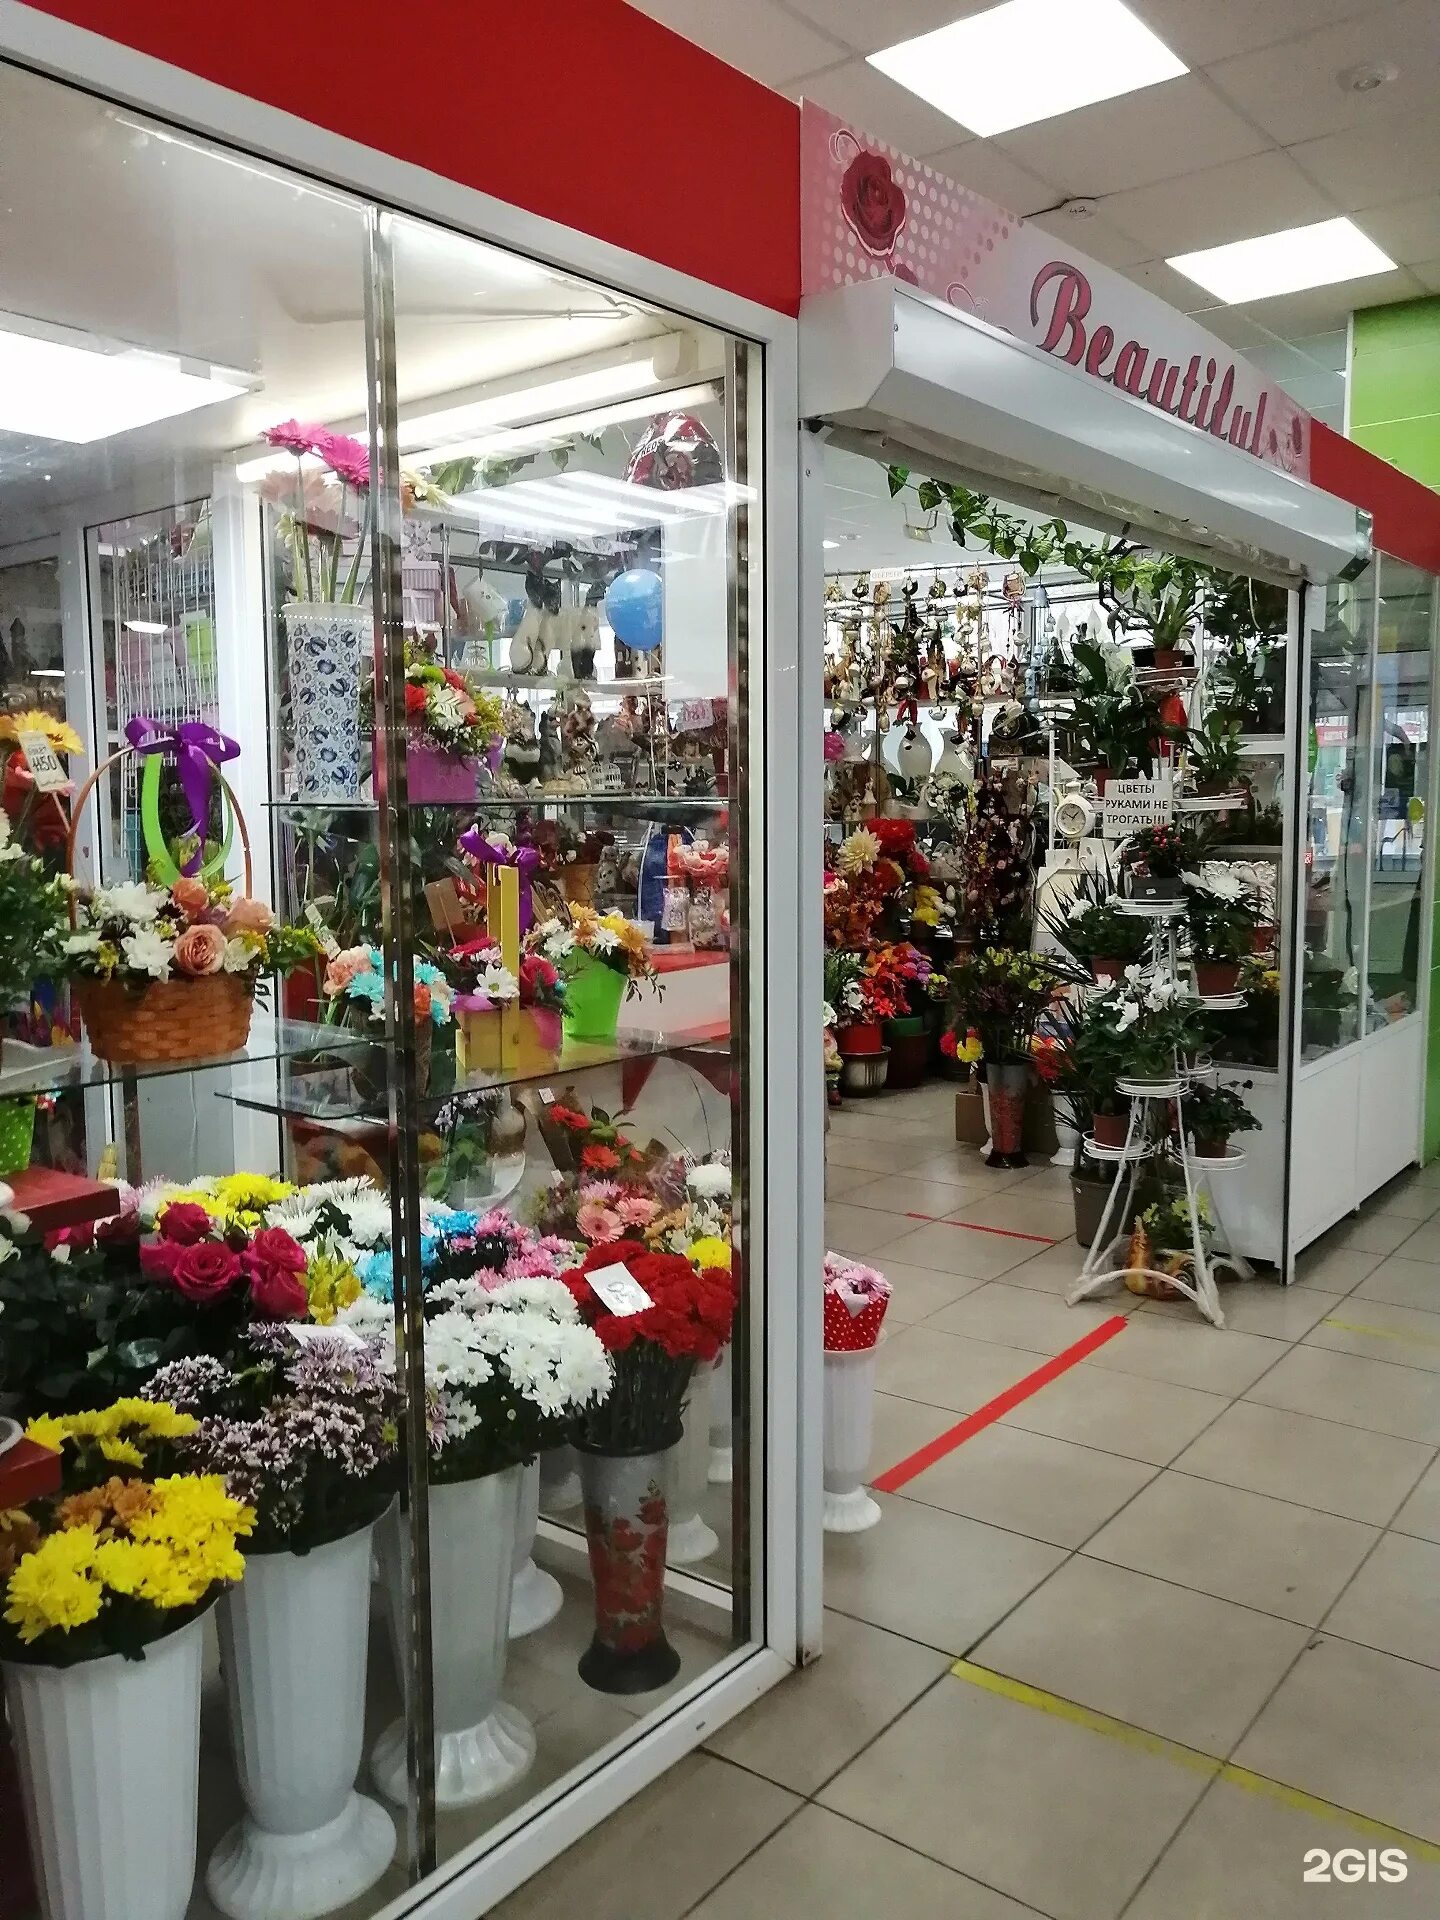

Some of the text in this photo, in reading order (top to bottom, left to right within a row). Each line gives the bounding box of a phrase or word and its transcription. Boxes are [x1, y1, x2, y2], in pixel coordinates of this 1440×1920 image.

[1118, 784, 1155, 795] ЦВЕТЫ
[1105, 799, 1168, 810] РУКАМИ НЕ
[1106, 814, 1165, 824] ТРОГАТЬ!!!
